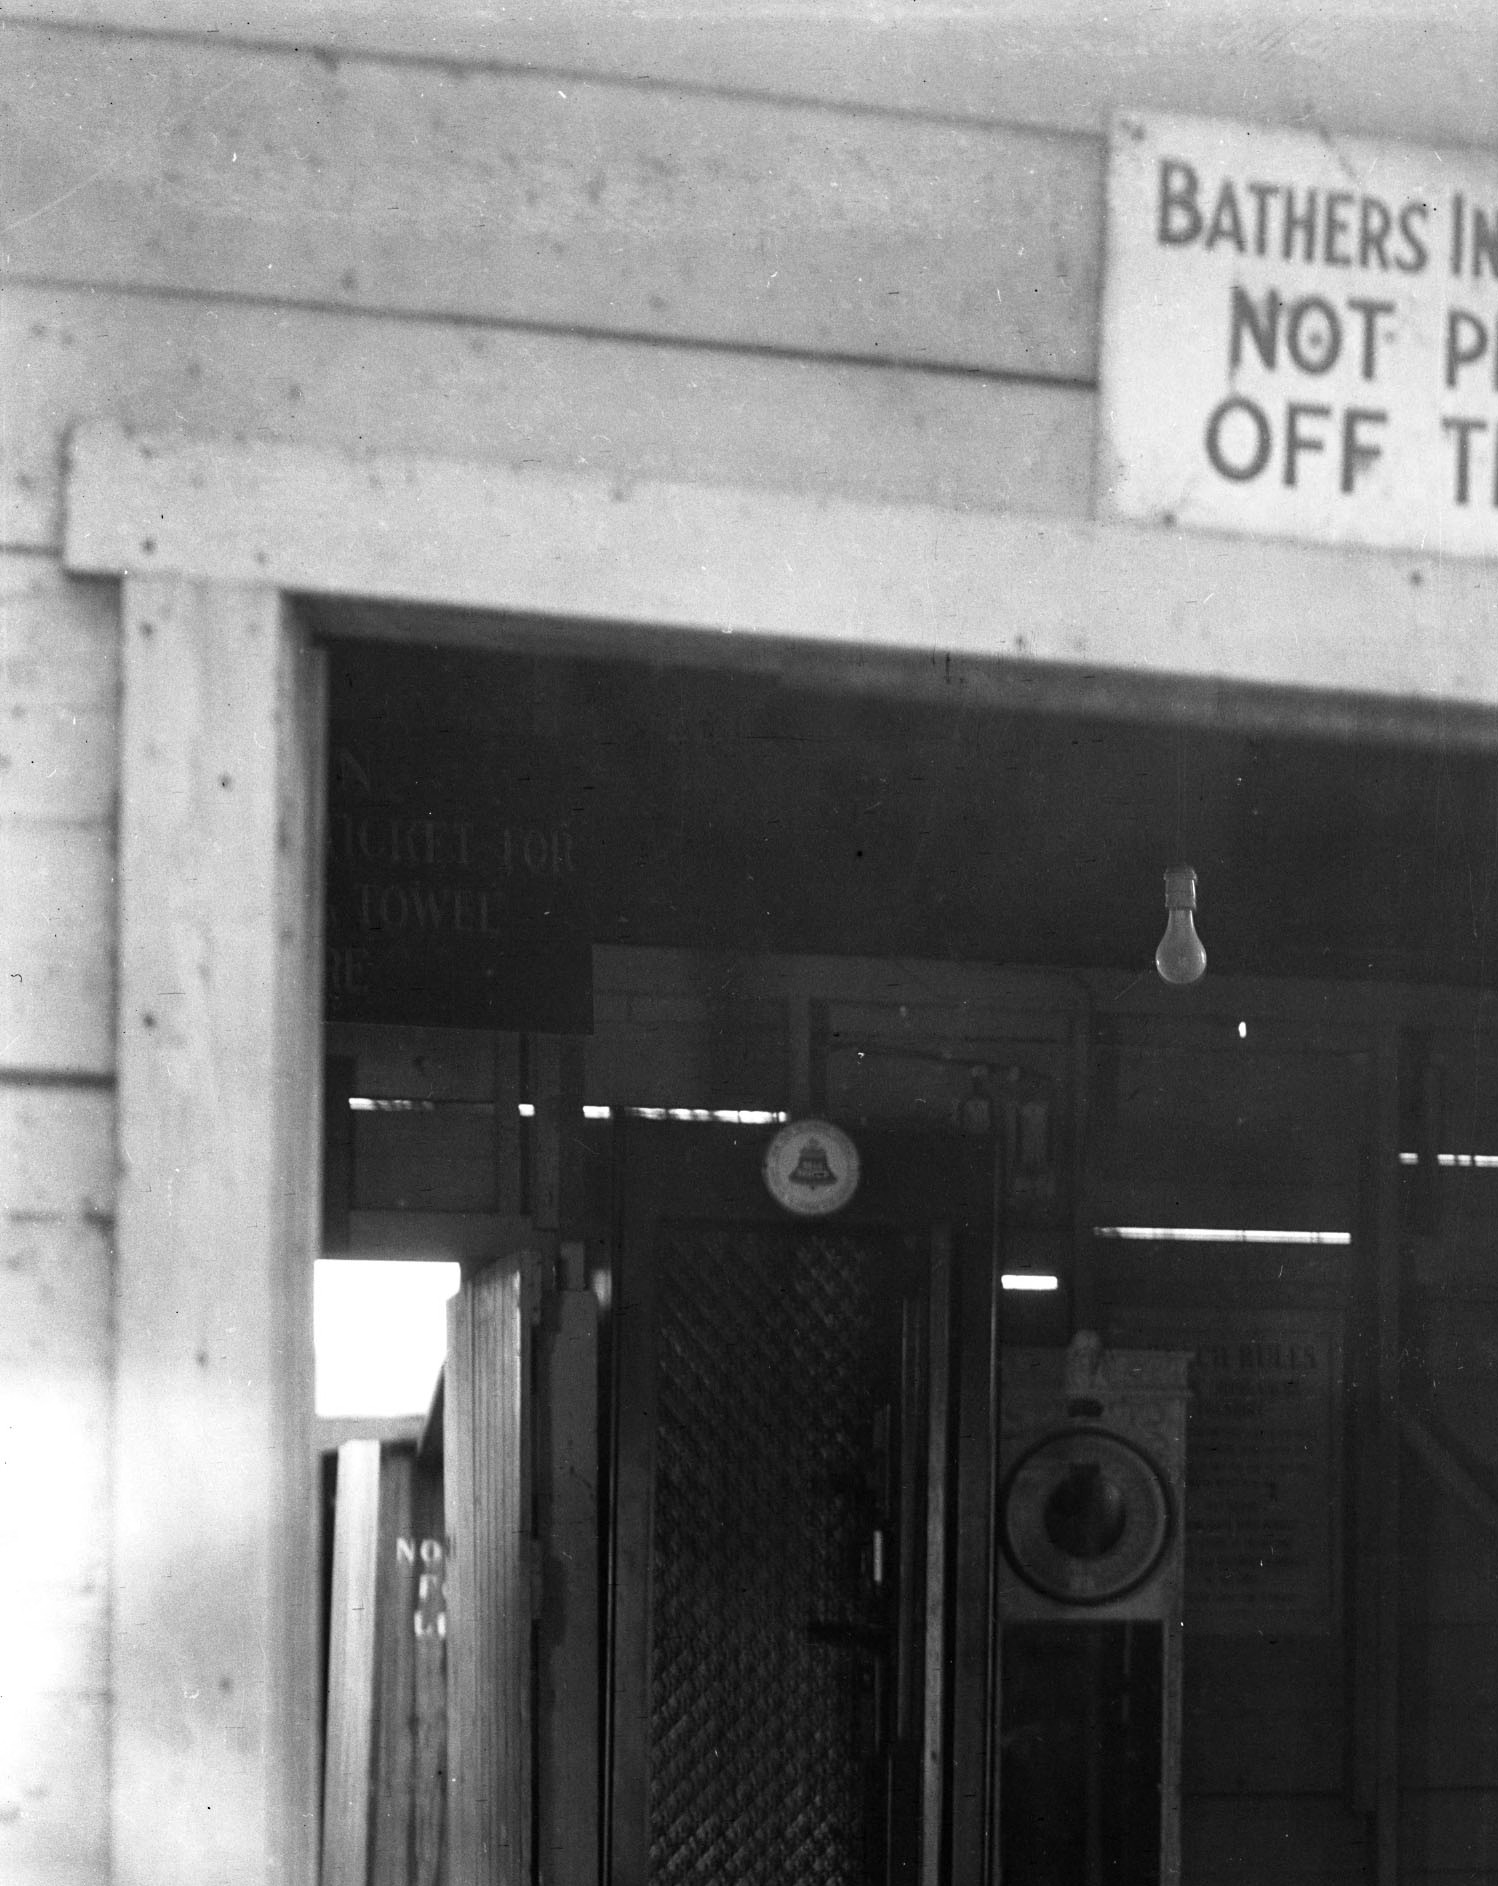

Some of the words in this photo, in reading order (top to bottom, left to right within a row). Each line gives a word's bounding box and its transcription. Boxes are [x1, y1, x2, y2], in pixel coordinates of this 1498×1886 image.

[1156, 158, 1431, 273] BATHERS
[1227, 288, 1396, 381] NOT
[1205, 397, 1388, 494] OFF
